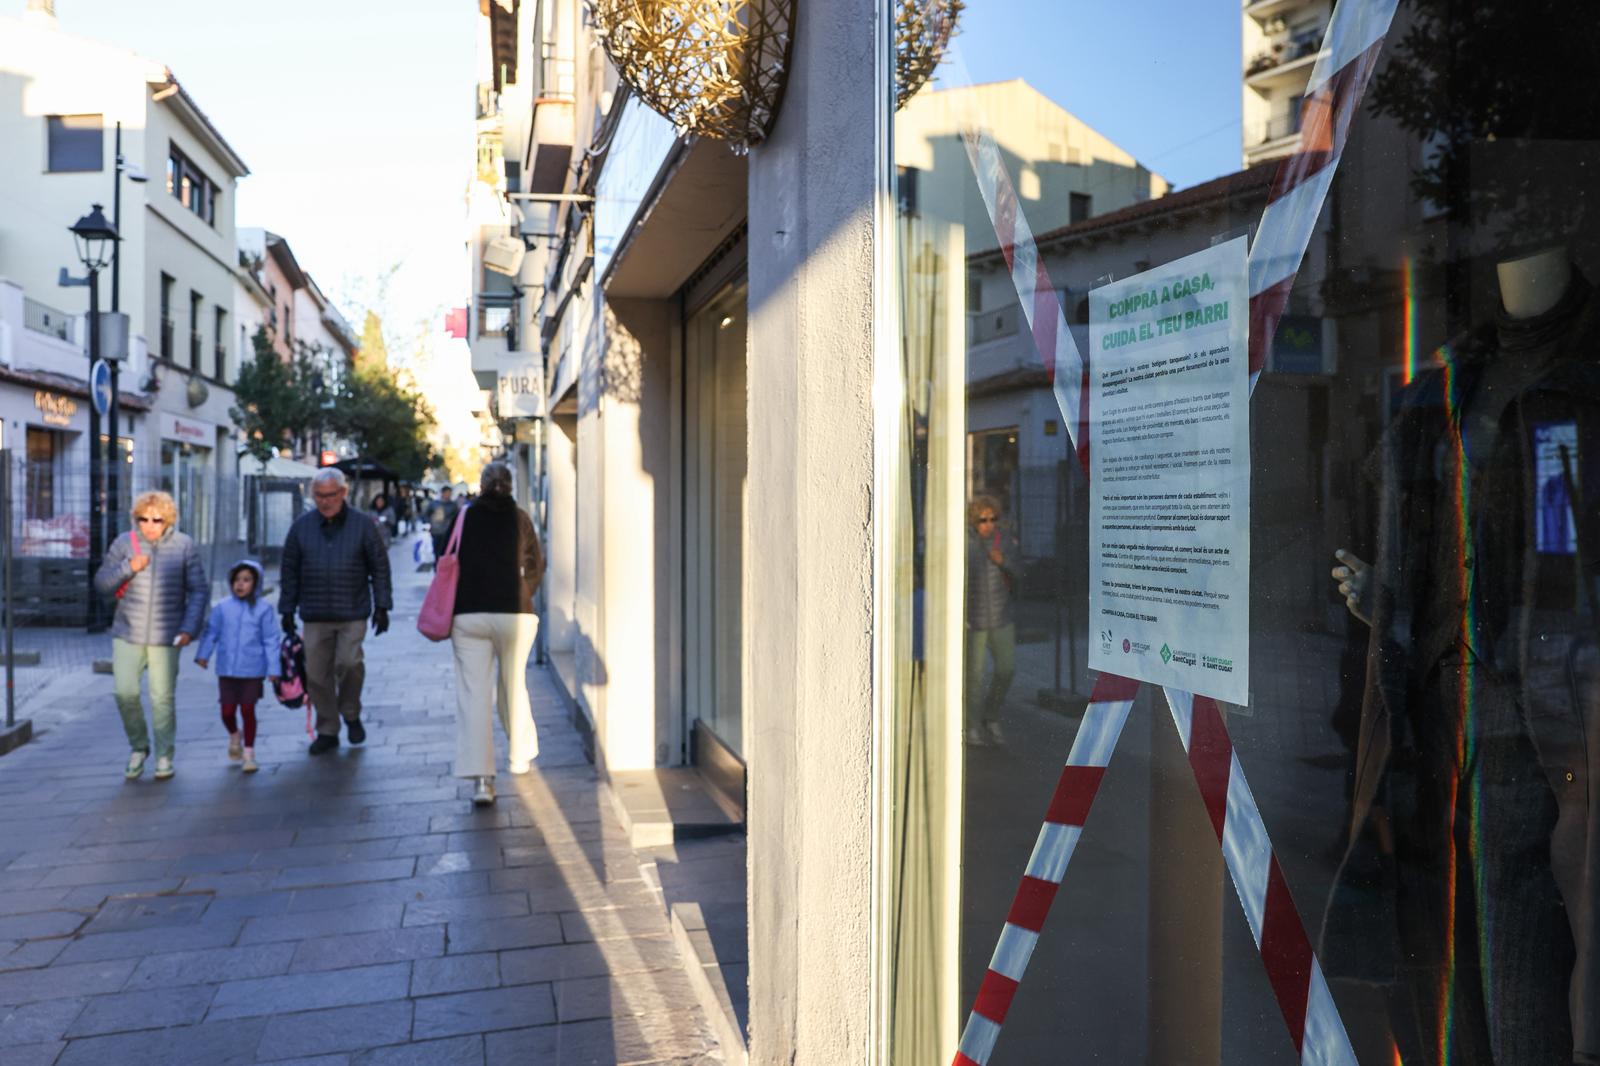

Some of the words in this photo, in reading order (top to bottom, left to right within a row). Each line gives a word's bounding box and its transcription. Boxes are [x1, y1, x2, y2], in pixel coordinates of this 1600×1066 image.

[1109, 290, 1158, 319] COMPRA
[1161, 286, 1170, 304] A
[1173, 272, 1215, 298] CASA,
[1102, 327, 1136, 350] CUIDA
[1140, 322, 1154, 341] EL
[1157, 314, 1182, 337] TEU
[1185, 301, 1228, 330] BARRI
[500, 376, 540, 393] PURA
